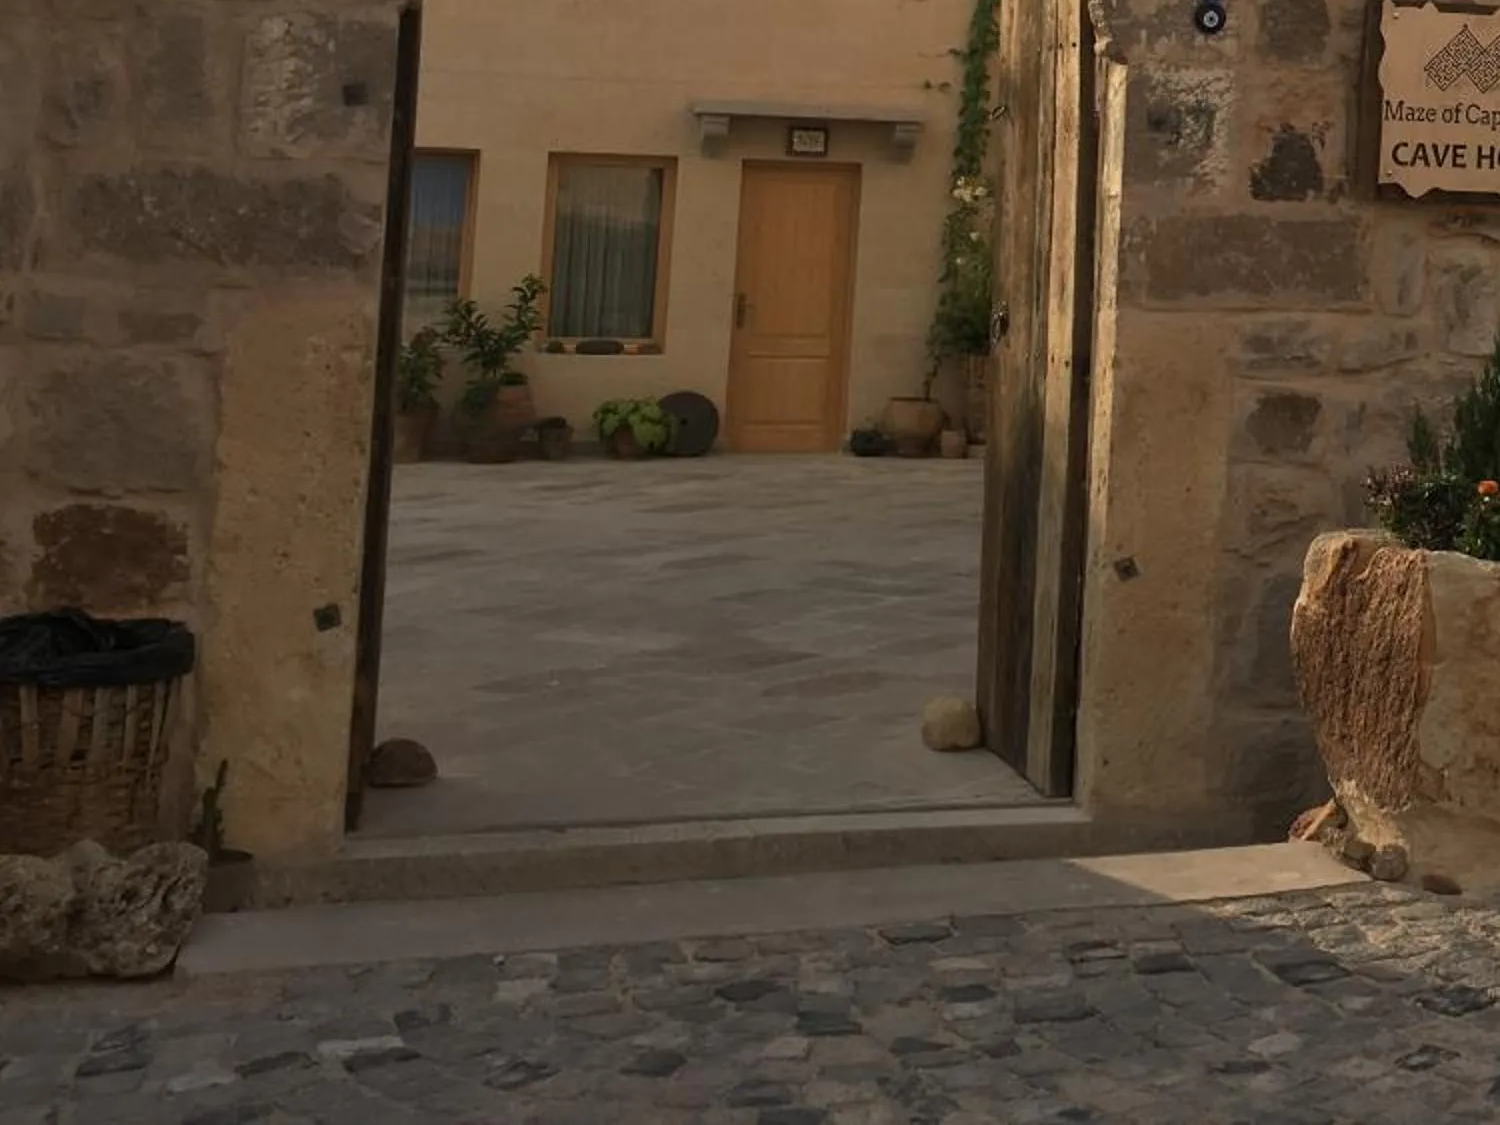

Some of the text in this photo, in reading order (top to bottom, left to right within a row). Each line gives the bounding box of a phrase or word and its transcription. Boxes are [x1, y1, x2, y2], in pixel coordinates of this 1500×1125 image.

[1383, 100, 1437, 123] Maze
[1442, 103, 1463, 124] of
[1391, 142, 1467, 168] CAVE
